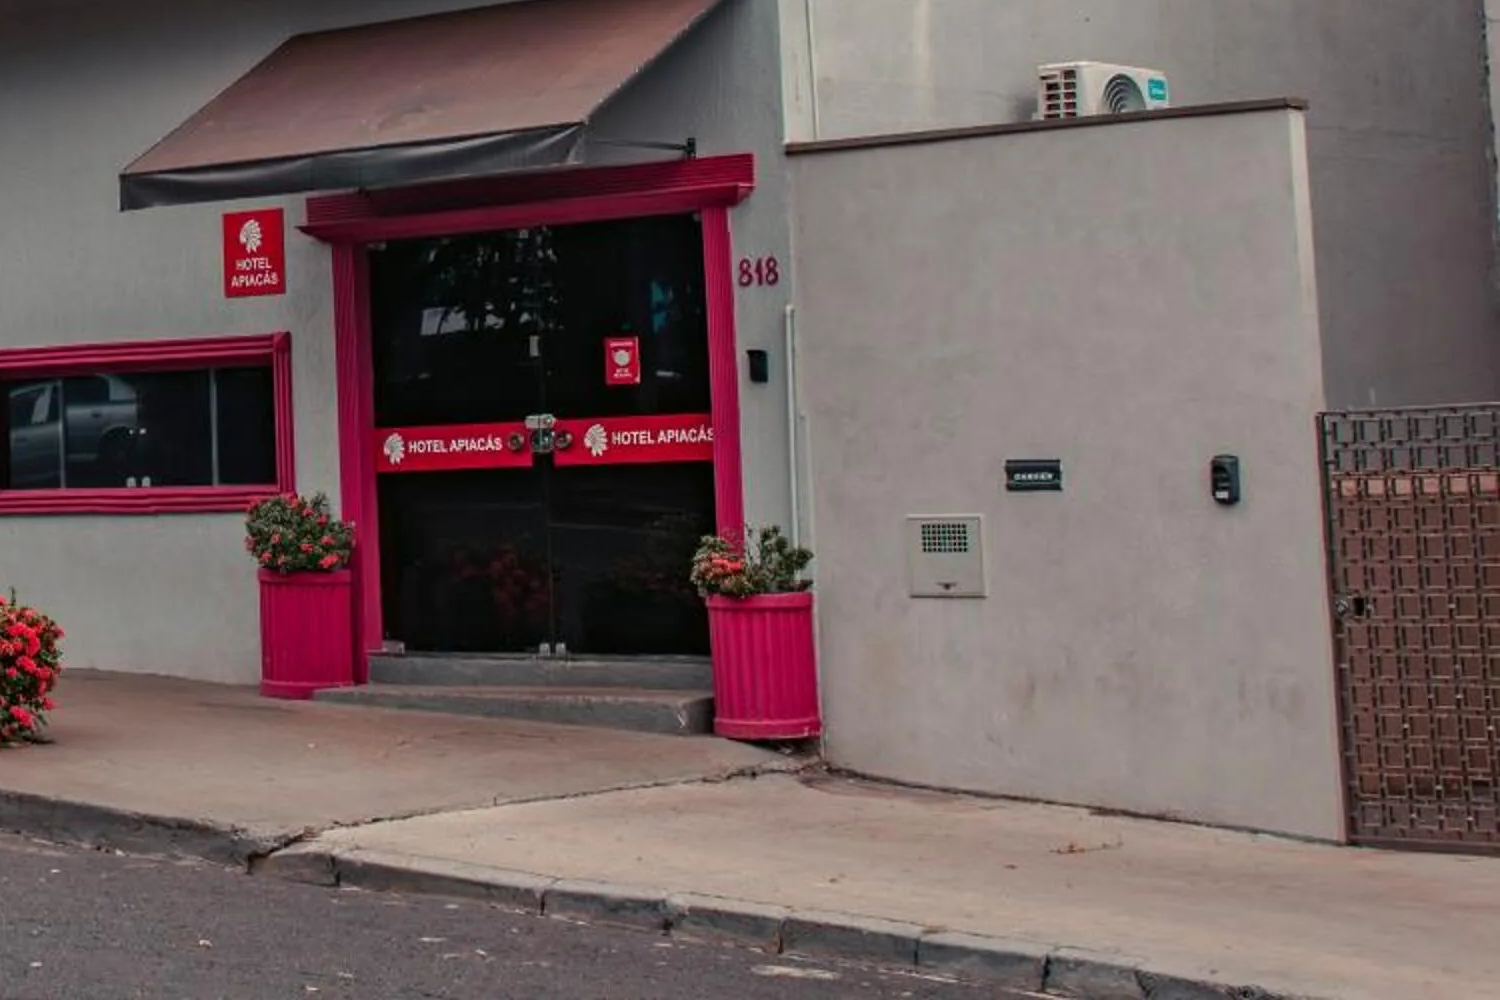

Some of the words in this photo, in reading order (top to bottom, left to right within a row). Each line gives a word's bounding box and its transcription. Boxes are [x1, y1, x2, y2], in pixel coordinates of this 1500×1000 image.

[235, 257, 272, 271] HOTEL
[738, 257, 779, 287] 818
[231, 269, 278, 288] APIACÁS
[408, 439, 448, 453] HOTEL
[449, 434, 503, 453] APIACÁS
[611, 430, 655, 445] HOTEL
